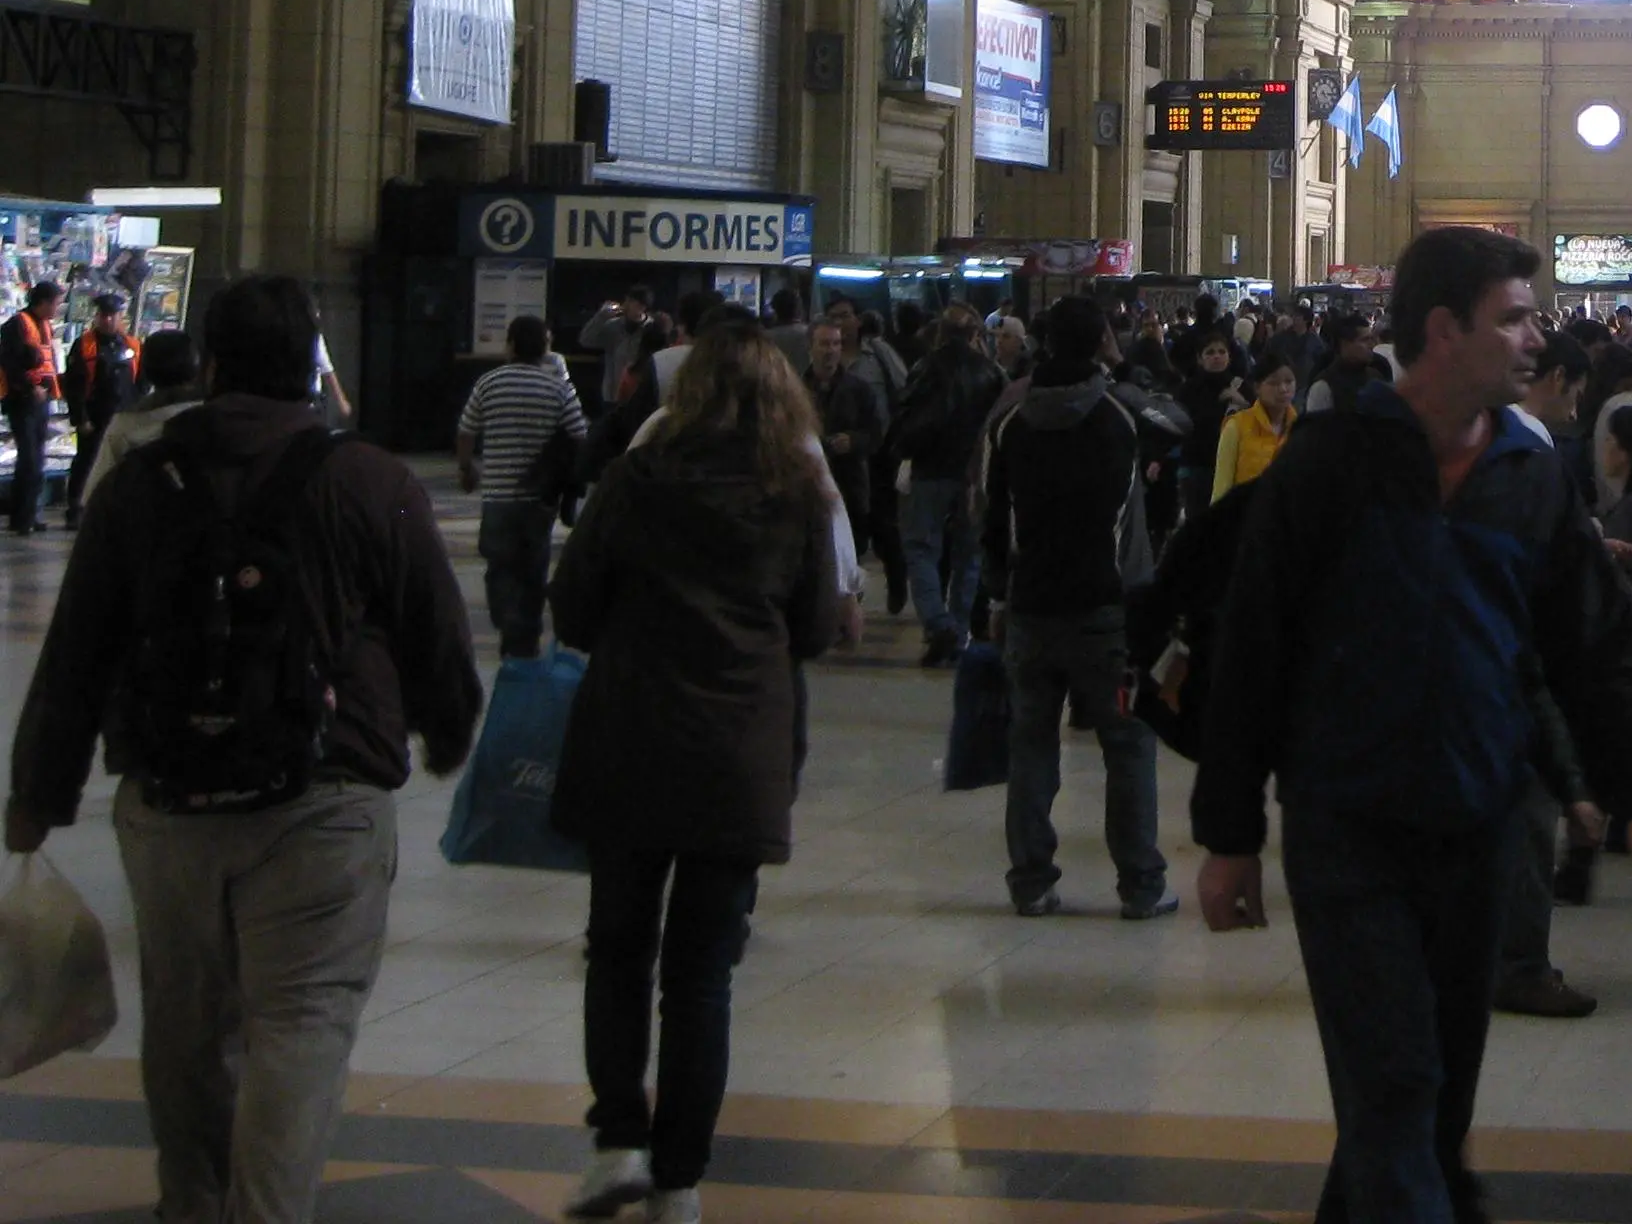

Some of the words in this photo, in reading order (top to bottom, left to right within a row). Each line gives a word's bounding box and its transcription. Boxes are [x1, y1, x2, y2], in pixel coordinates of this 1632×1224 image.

[1099, 110, 1114, 139] 6
[1273, 150, 1287, 172] 4
[567, 209, 778, 252] INFORMES
